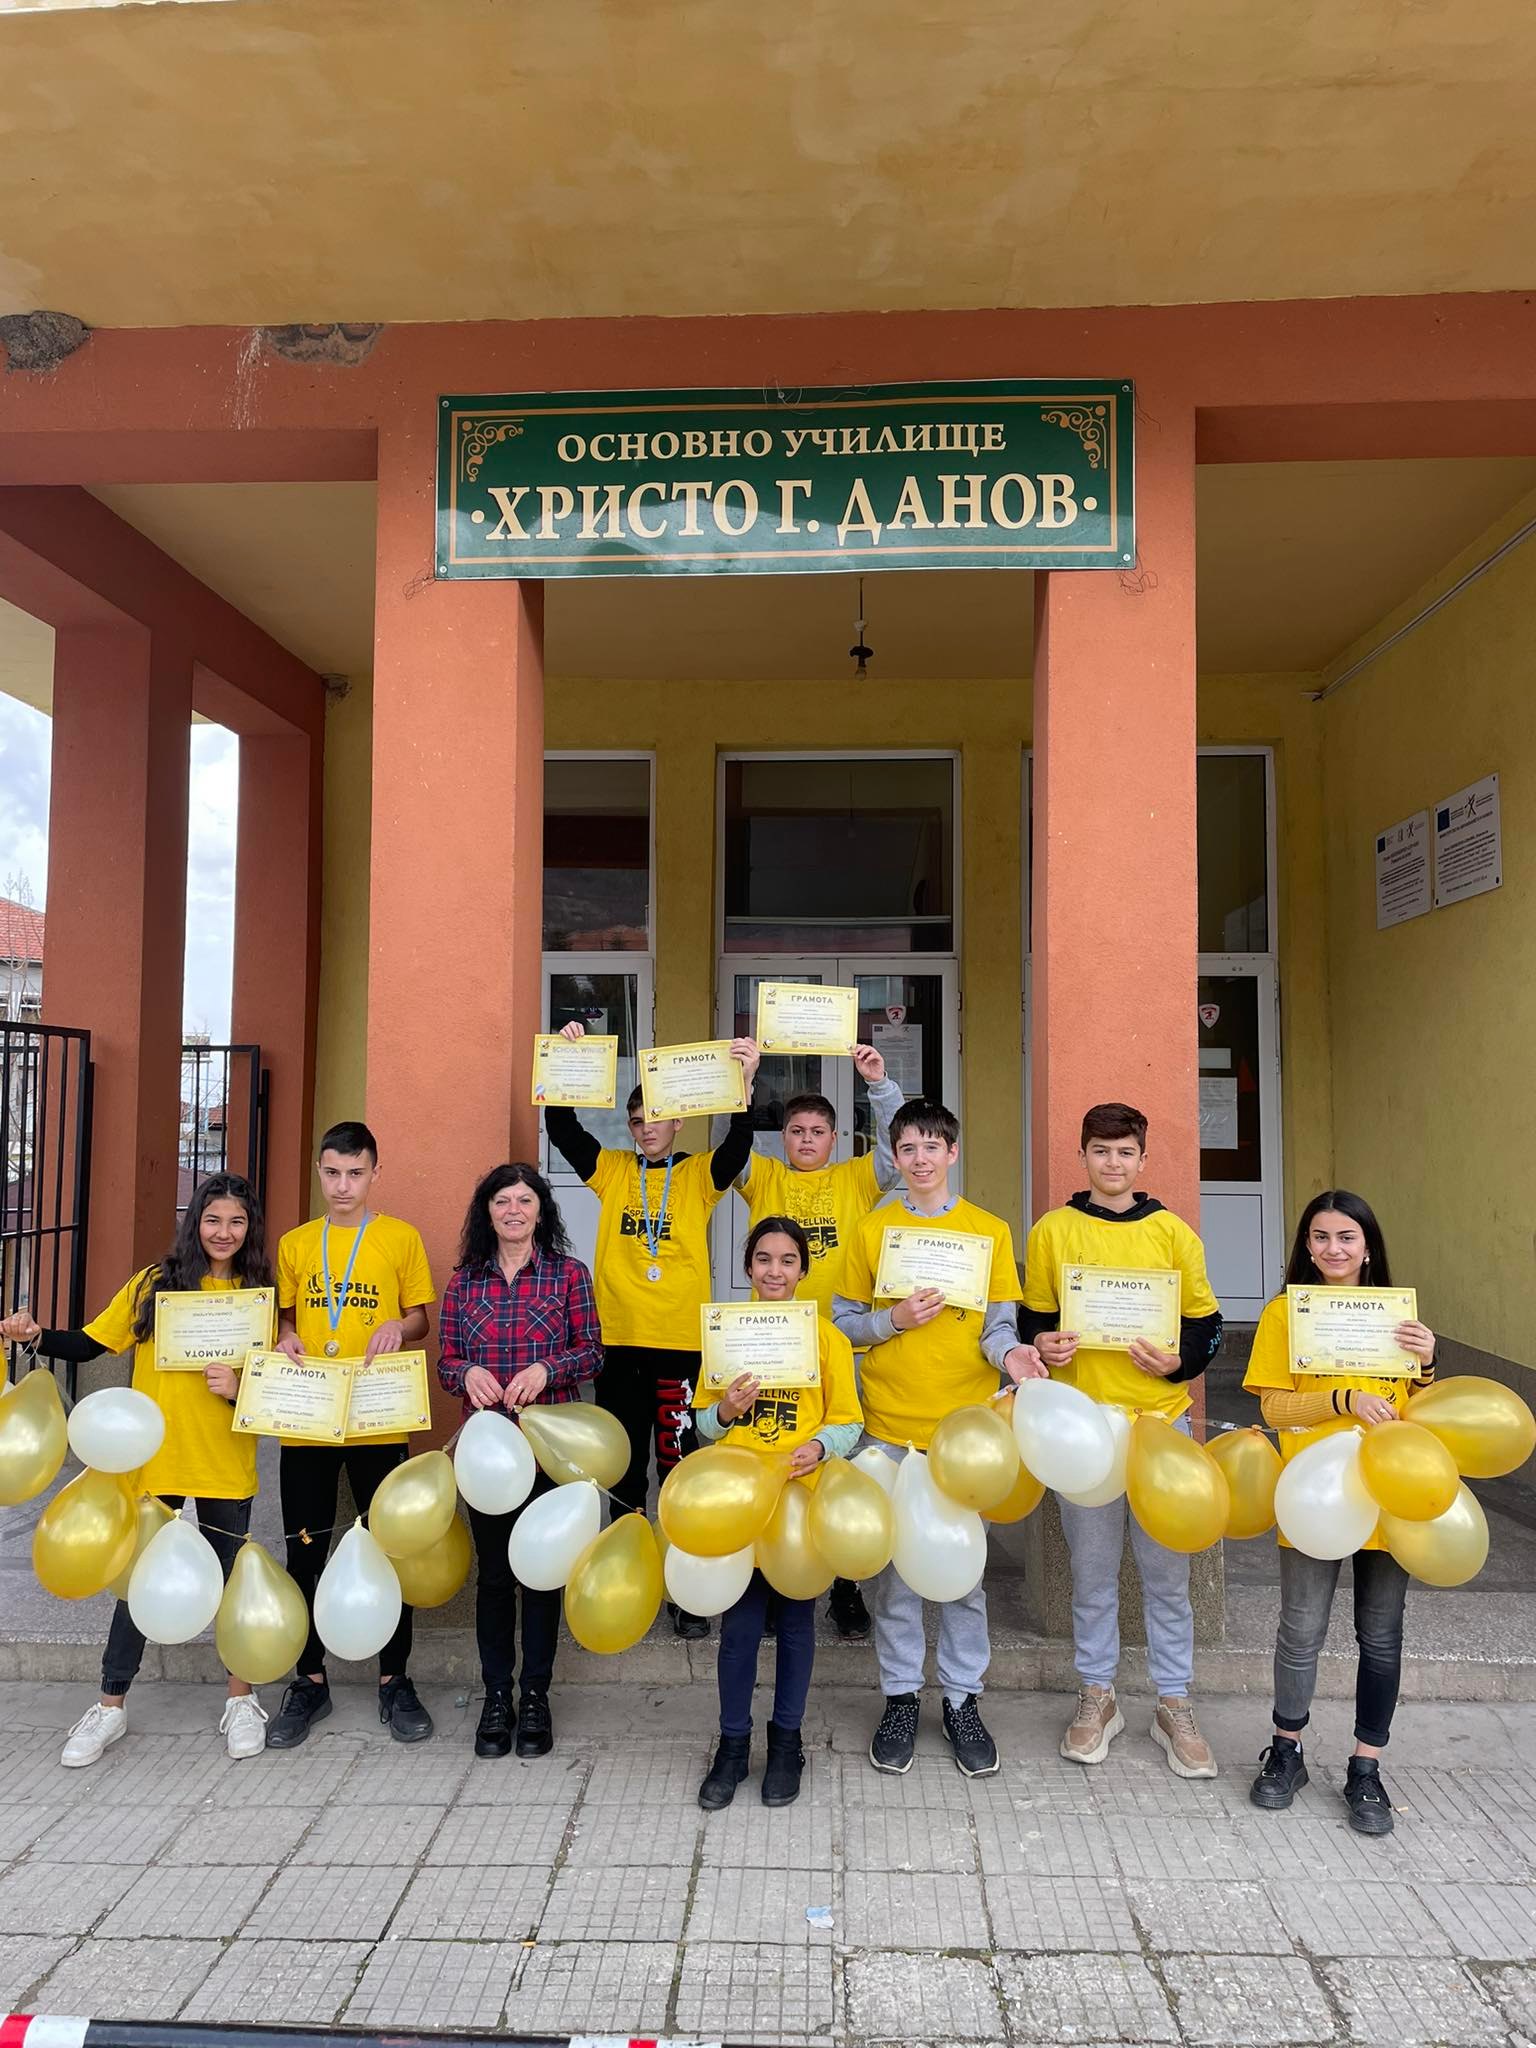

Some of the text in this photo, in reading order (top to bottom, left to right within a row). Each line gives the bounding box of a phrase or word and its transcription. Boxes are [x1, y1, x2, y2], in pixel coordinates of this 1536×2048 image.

[557, 422, 1007, 463] ОСНОВНО УЧИЛИЩЕ
[485, 472, 1081, 546] ХРИСТО Г. ДАНОВ
[791, 995, 833, 1004] ГРАМОТА
[673, 1053, 717, 1065] ГРАМОТА
[917, 1238, 965, 1252] ГРАМОТА
[334, 1282, 380, 1296] SPELL
[1100, 1280, 1151, 1291] ГРАМОТА
[1330, 1301, 1385, 1311] ГРАМОТА
[739, 1315, 789, 1325] ГРАМОТА
[184, 1349, 234, 1358] ГРАМОТА
[280, 1367, 327, 1380] ГРАМОТА
[376, 1365, 412, 1376] WINNER
[758, 1389, 801, 1402] ELLING
